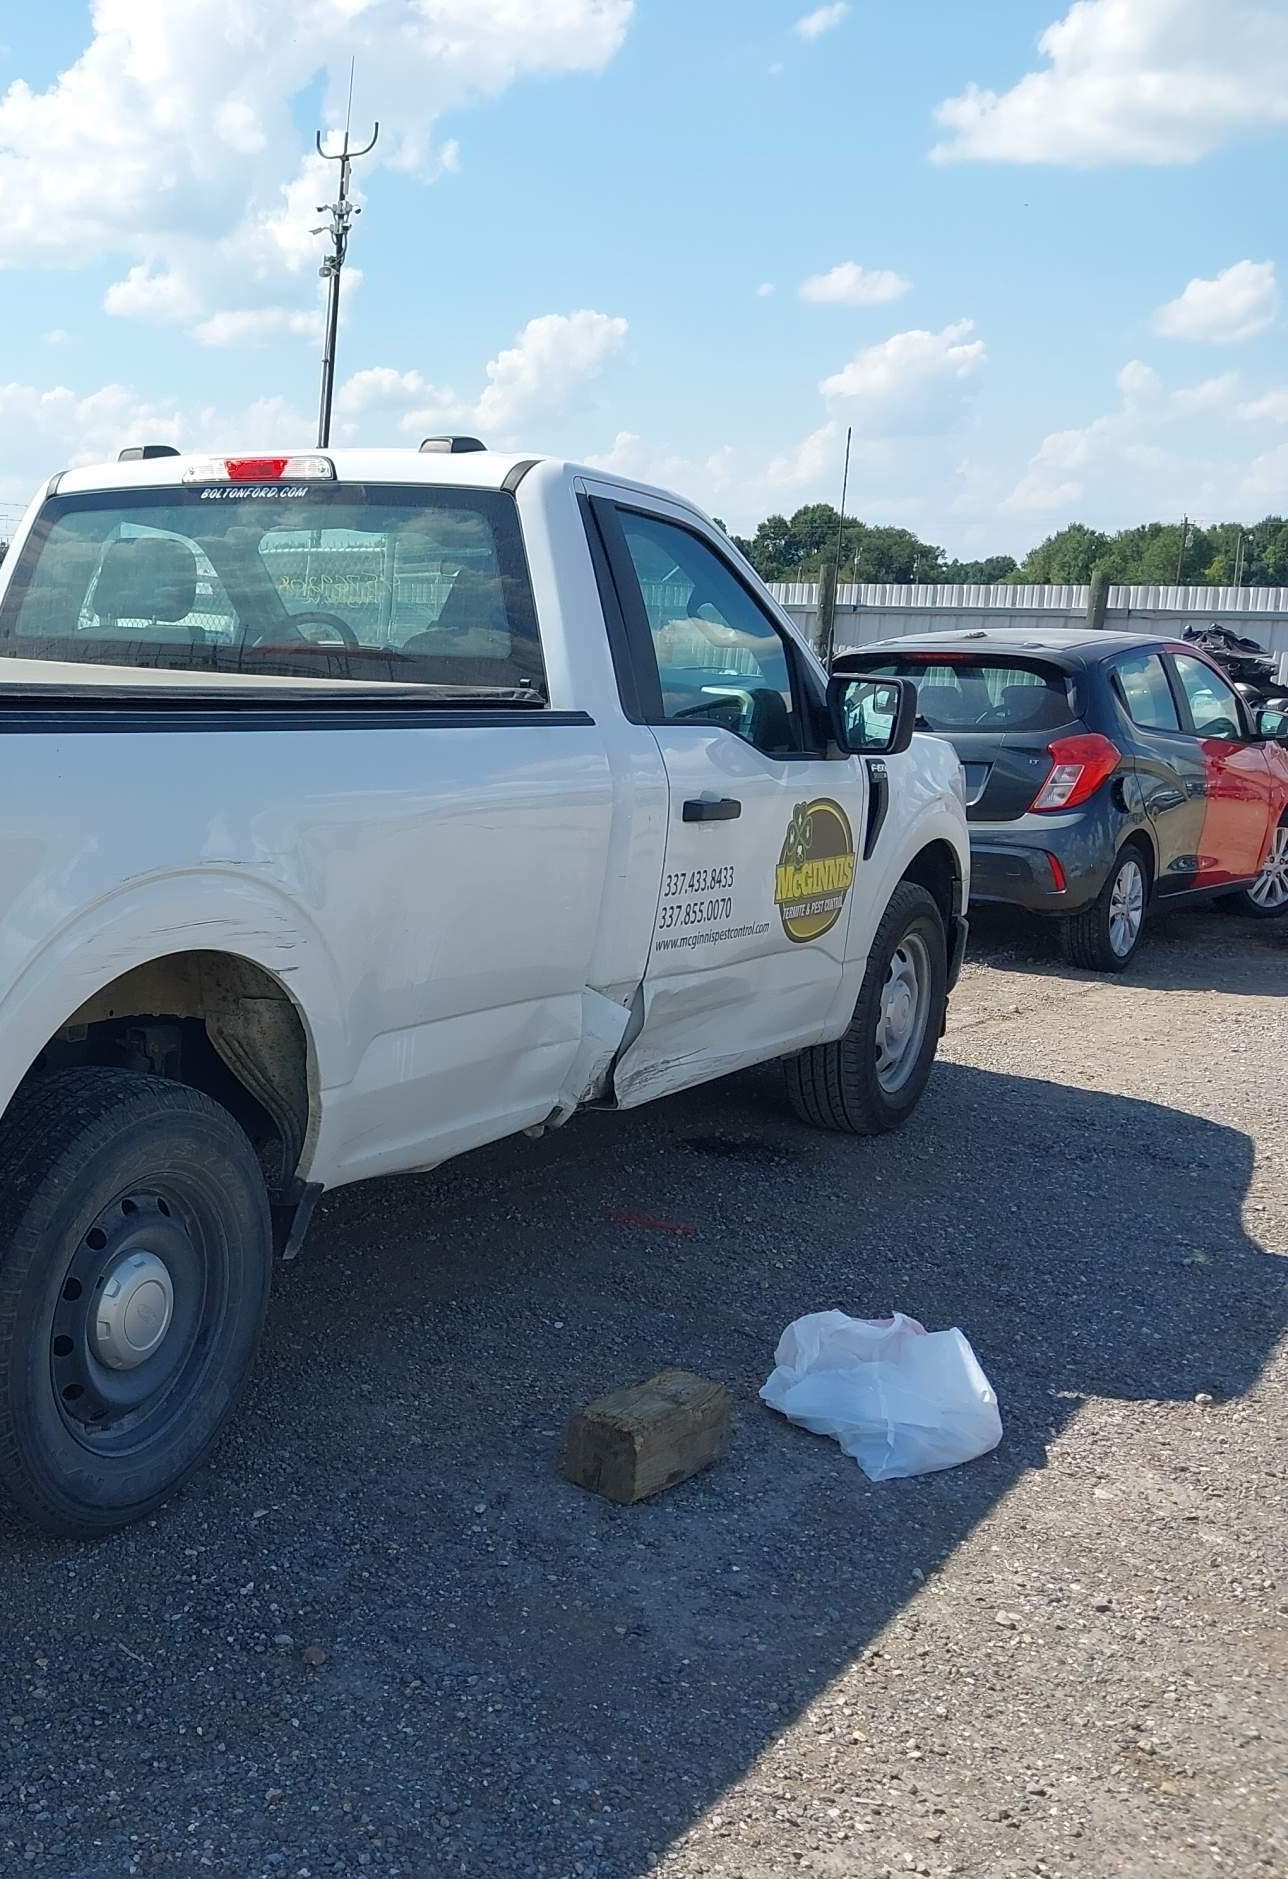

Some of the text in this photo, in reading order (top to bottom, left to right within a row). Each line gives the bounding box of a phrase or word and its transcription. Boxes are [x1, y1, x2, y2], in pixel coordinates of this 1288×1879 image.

[200, 487, 309, 499] BOLTONFORD.COM
[663, 865, 735, 897] 337.433.8433
[775, 855, 853, 900] McGINNIS
[658, 896, 733, 930] 337.855.0070
[811, 900, 825, 914] PEST
[655, 921, 770, 951] www.mcginnispestcontrol.com
